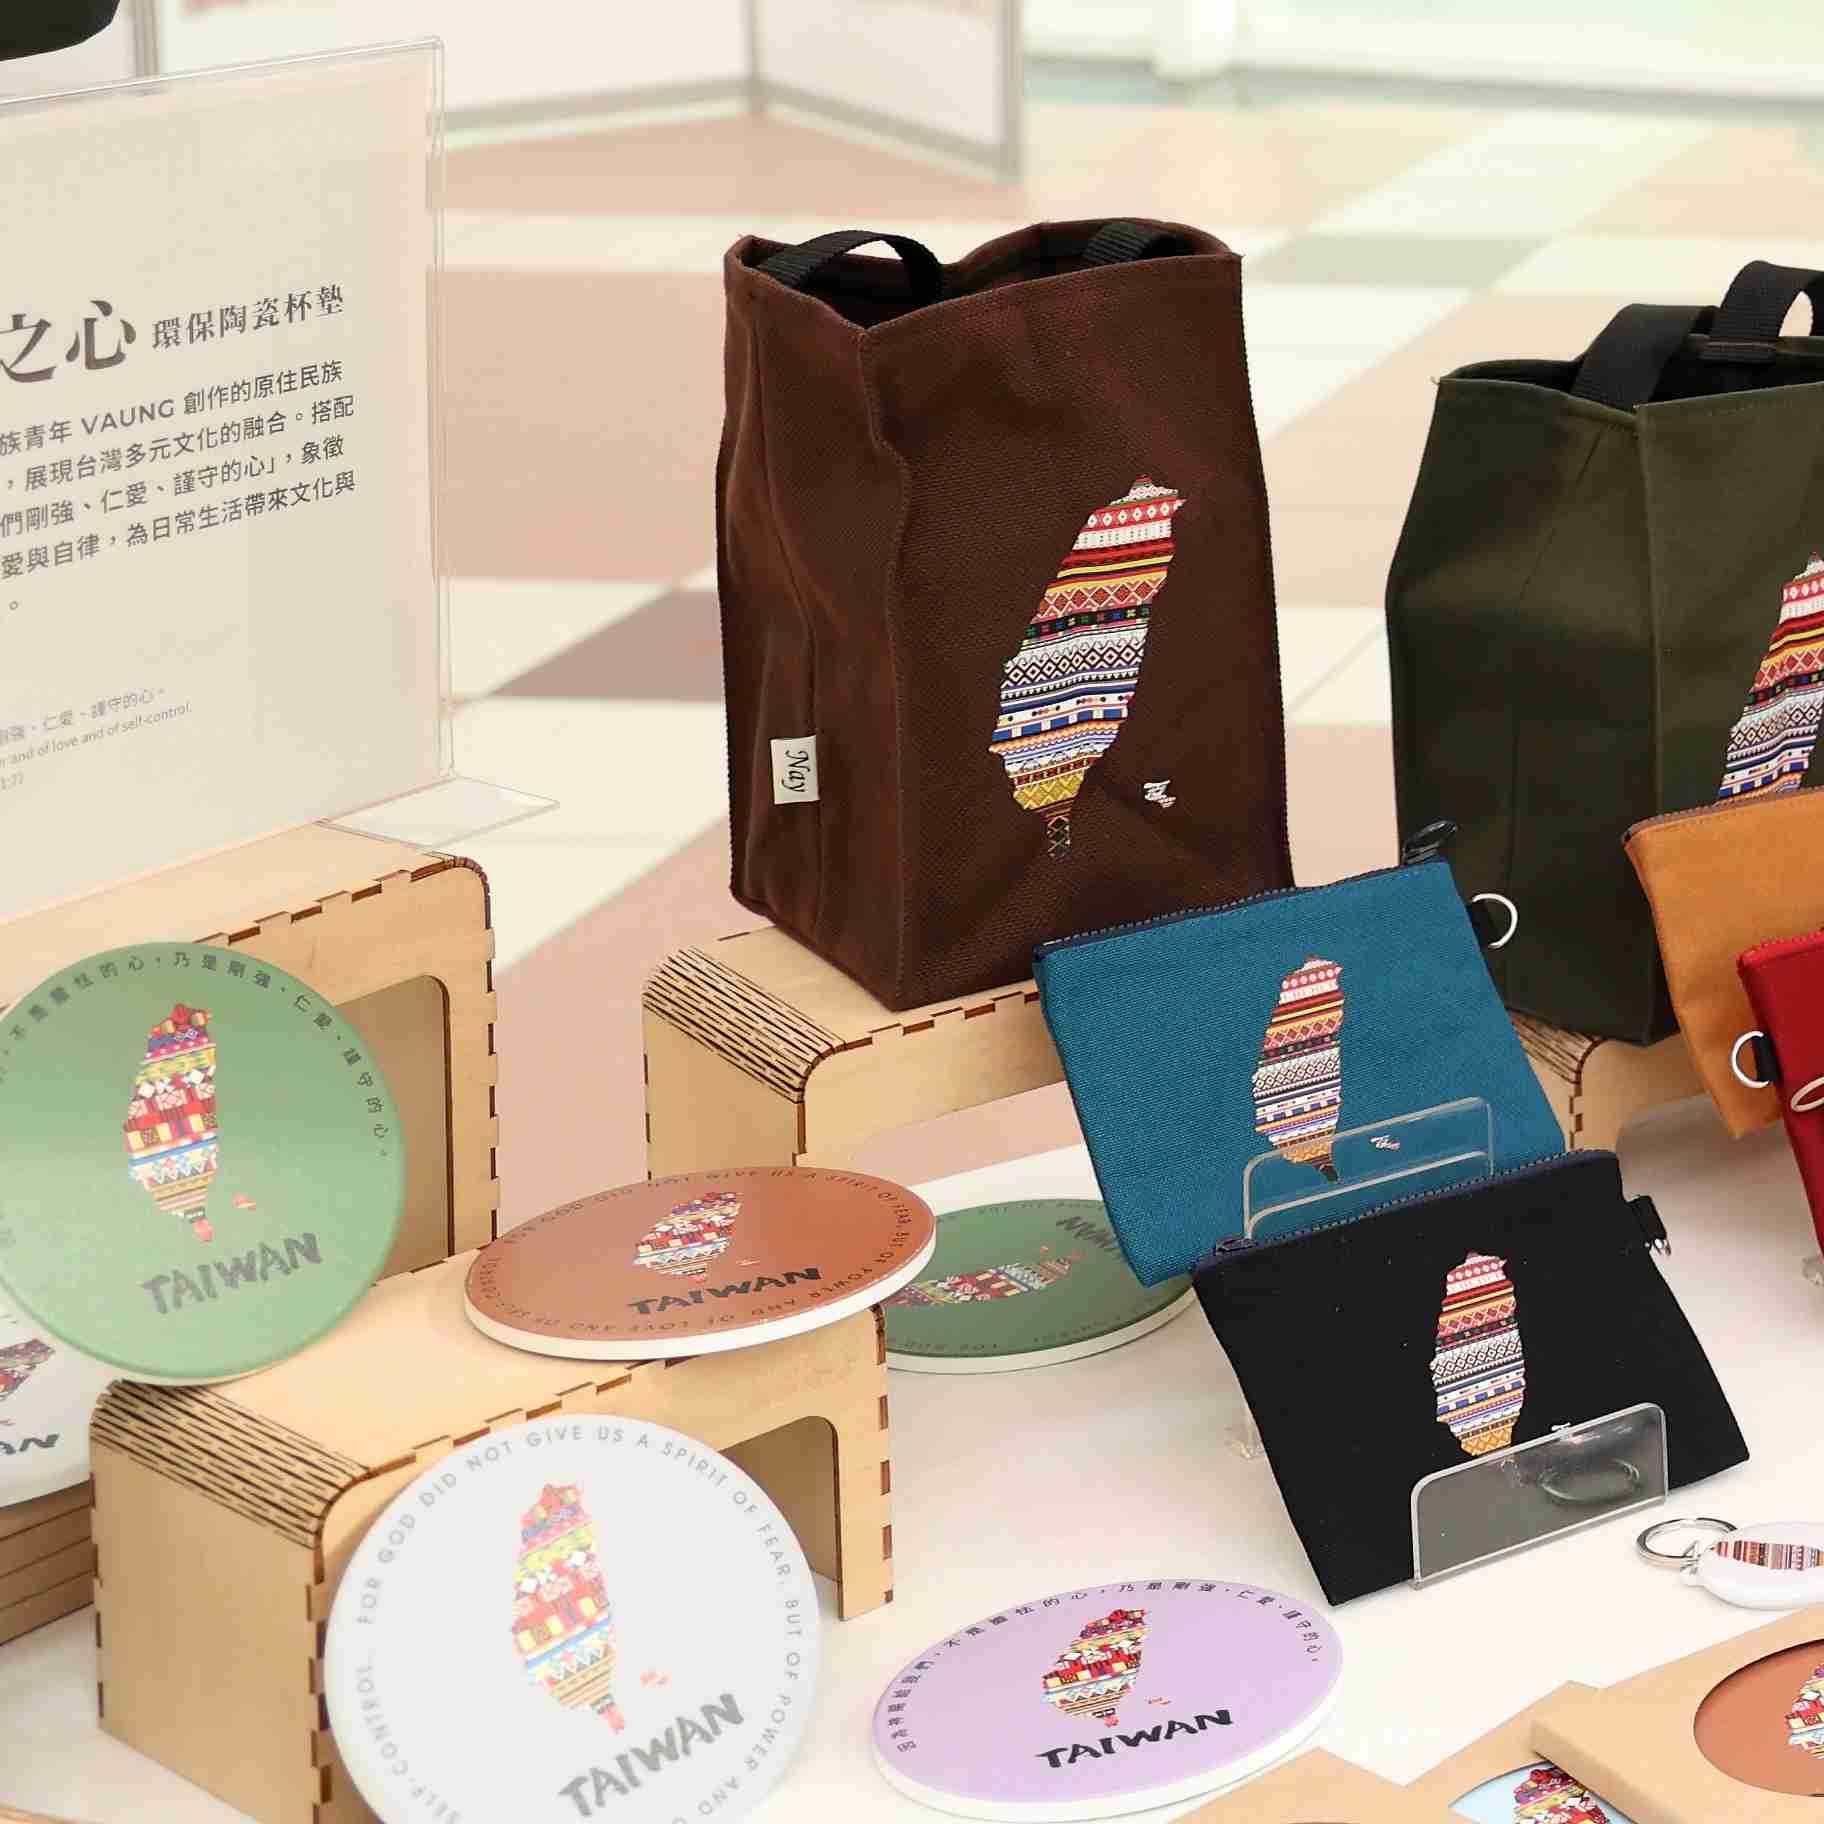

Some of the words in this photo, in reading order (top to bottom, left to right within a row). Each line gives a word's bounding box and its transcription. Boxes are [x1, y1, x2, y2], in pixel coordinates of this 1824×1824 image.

[151, 284, 344, 351] 環保陶瓷杯墊
[81, 399, 176, 437] VAUNG
[183, 359, 343, 416] 創作的原住民族
[781, 749, 811, 793] Nay
[141, 1231, 324, 1317] TAIWAN
[626, 1267, 823, 1315] TAIWAN
[465, 1439, 513, 1473] NOT
[525, 1423, 584, 1449] GIVE
[597, 1424, 626, 1444] US
[636, 1433, 650, 1449] A
[661, 1439, 729, 1488] SPIRIT
[418, 1470, 459, 1508] DID
[731, 1488, 759, 1518] OF
[378, 1512, 417, 1565] GOD
[356, 1577, 381, 1625] FOR
[784, 1598, 802, 1639] BUT
[784, 1650, 801, 1682] OF
[556, 1692, 744, 1819] TAIWAN
[742, 1693, 792, 1773] POWER
[1036, 1708, 1232, 1768] TAIWAN
[697, 1776, 740, 1819] AND
